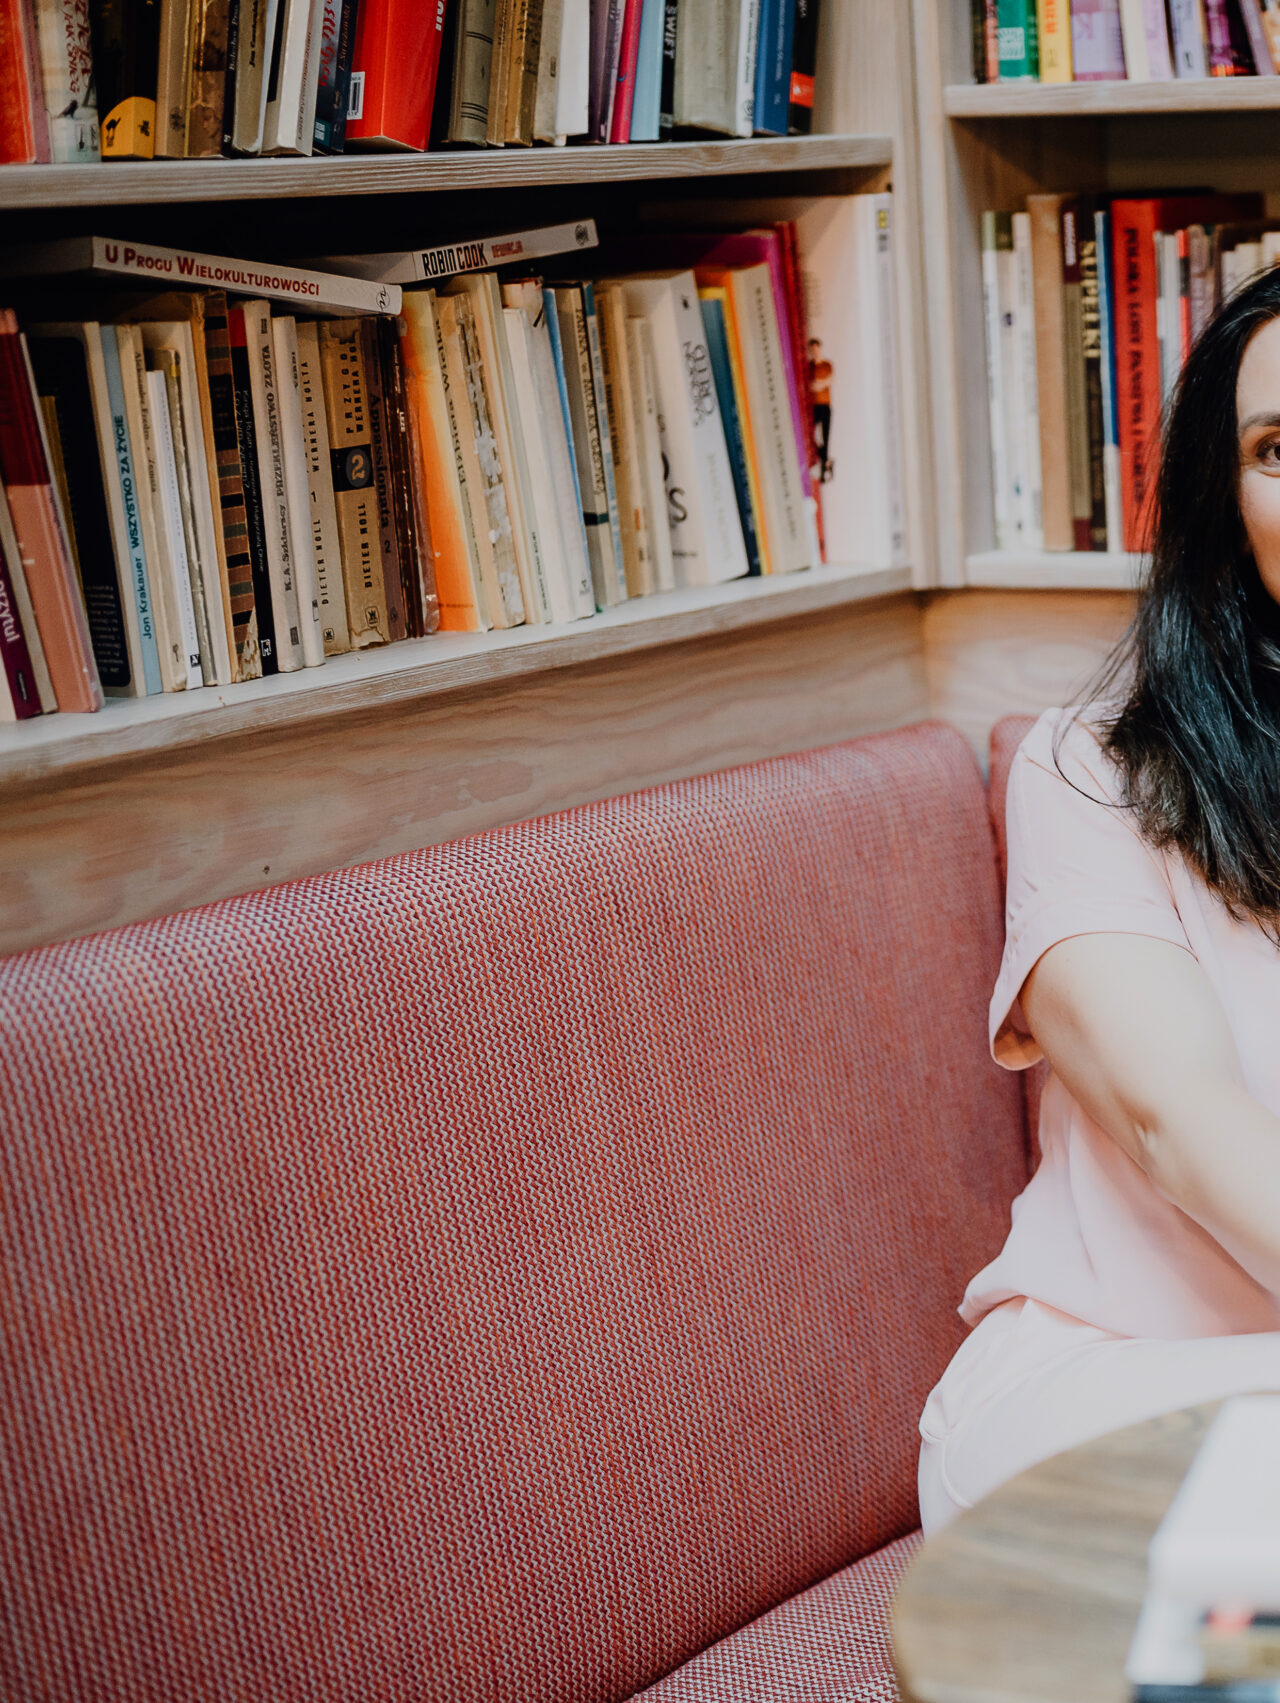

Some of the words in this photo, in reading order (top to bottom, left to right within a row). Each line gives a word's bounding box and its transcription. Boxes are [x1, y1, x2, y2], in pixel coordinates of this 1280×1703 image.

[663, 6, 678, 59] SWIFT
[105, 243, 118, 264] U
[421, 248, 457, 278] ROBIN
[456, 242, 489, 271] COOK
[262, 345, 275, 389] ZŁOTA
[301, 360, 313, 403] HOLTA
[350, 370, 365, 433] WERNERA
[113, 415, 128, 454] ŻYCIE
[267, 392, 285, 497] PRZEKLEŃSTWO
[306, 411, 320, 473] WERNERA
[119, 455, 131, 476] ZA
[351, 455, 366, 481] 2
[368, 392, 391, 529] Appassionata
[383, 540, 392, 554] 2
[121, 480, 141, 550] WSZYSTKO
[312, 519, 323, 551] NOLL
[358, 503, 369, 535] NOLL
[135, 556, 151, 614] Krakauer
[316, 559, 330, 605] DIETER
[359, 541, 374, 588] DIETER
[142, 617, 153, 640] Jon
